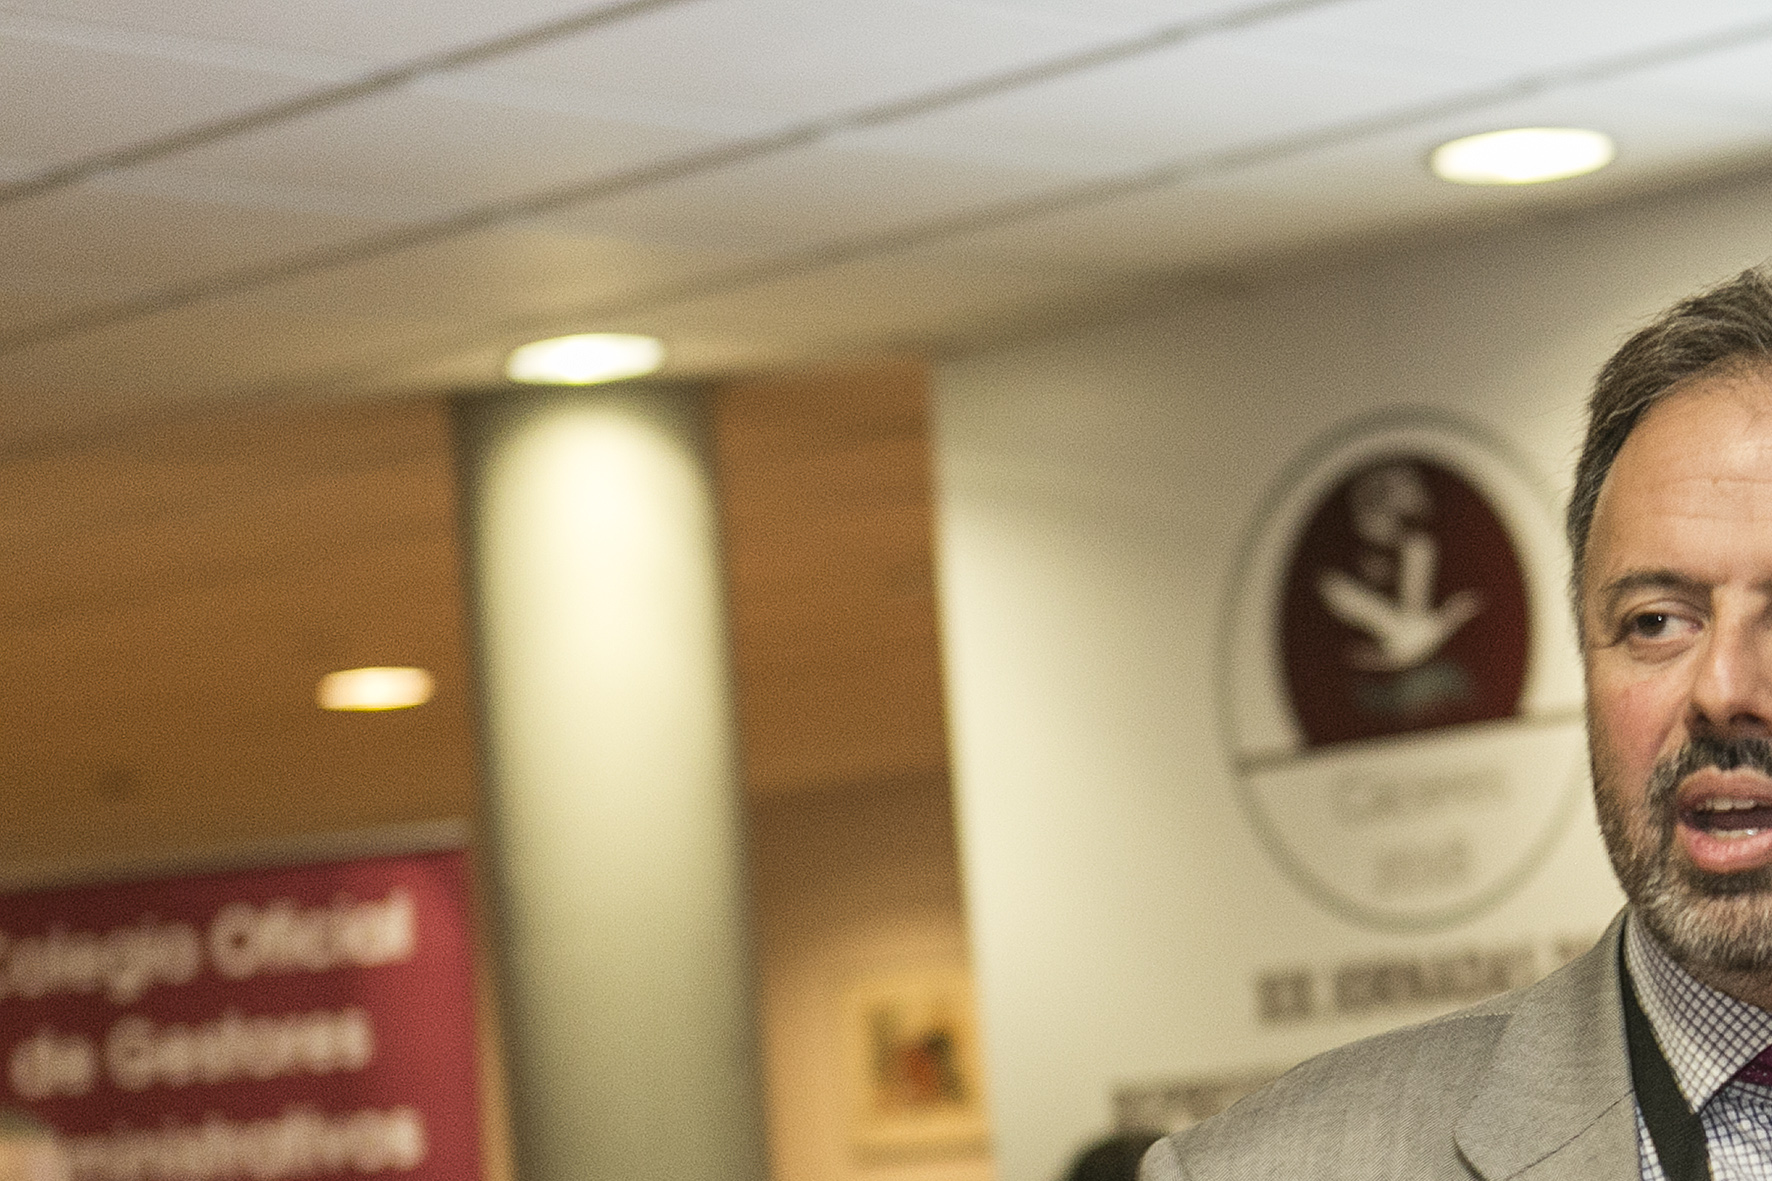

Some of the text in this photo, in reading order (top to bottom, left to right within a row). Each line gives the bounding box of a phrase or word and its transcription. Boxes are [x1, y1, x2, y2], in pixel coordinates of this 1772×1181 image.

[0, 888, 418, 1004] olegio Oficial
[8, 1004, 376, 1102] de Gestores
